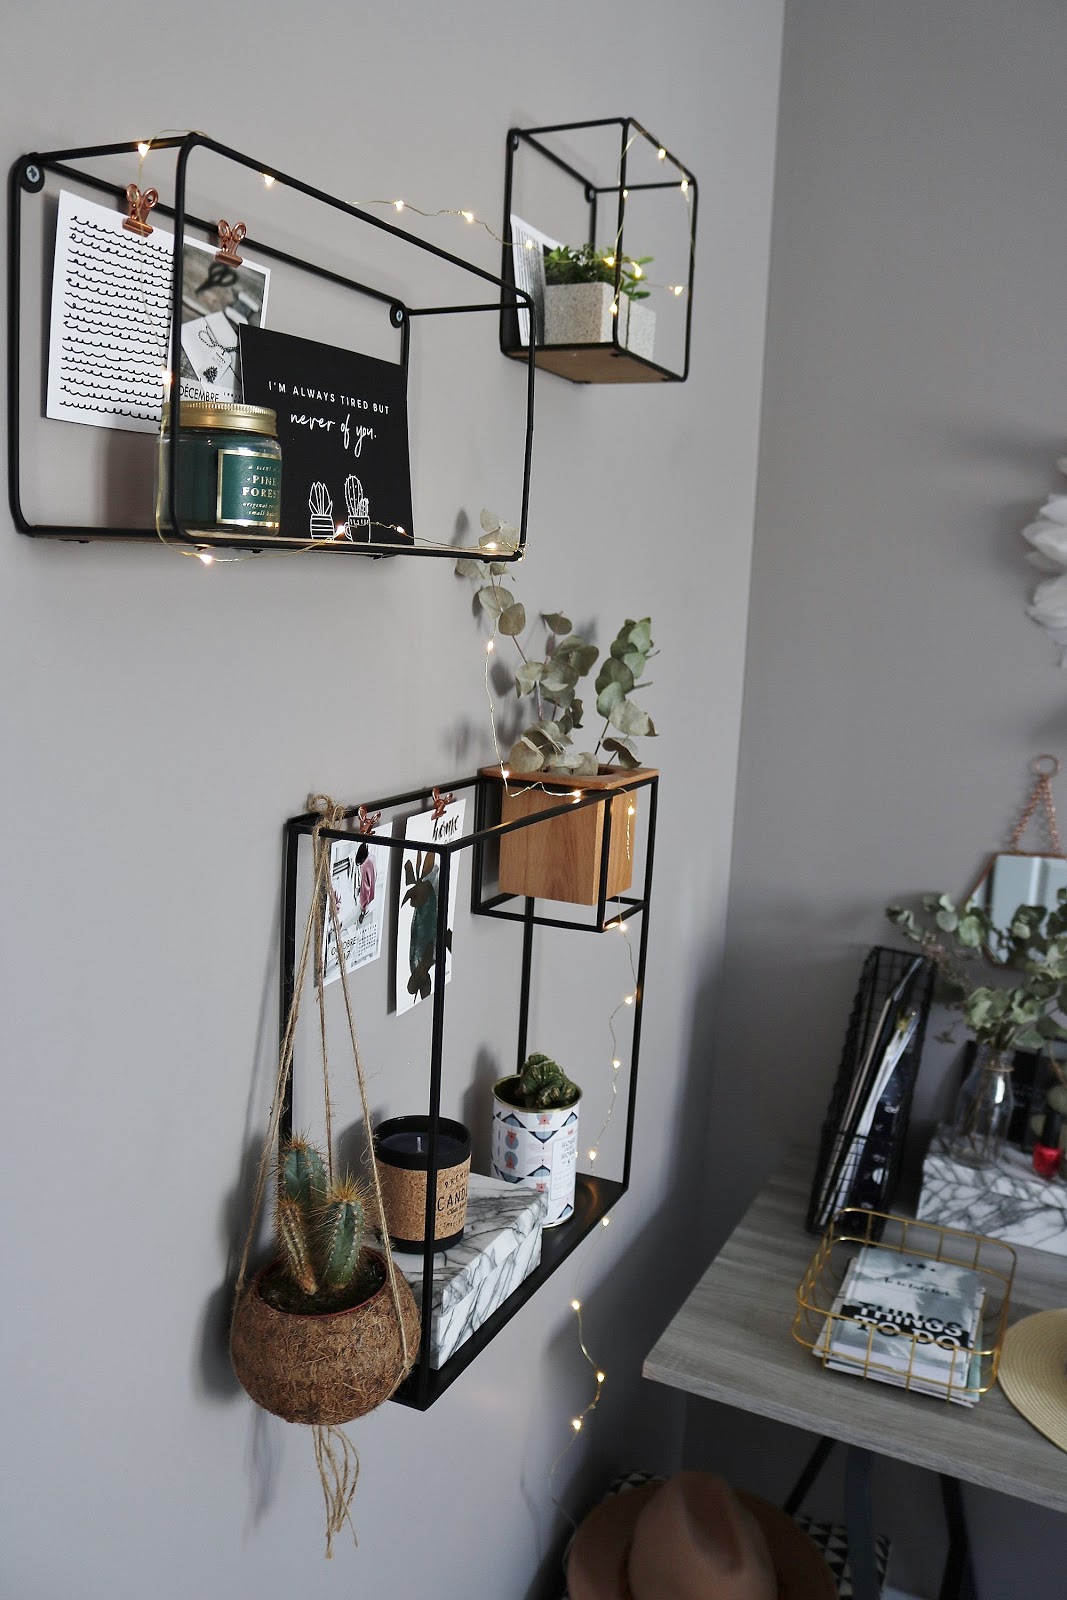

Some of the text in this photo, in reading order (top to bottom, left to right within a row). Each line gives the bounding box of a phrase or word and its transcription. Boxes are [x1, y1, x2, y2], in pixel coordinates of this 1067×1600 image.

[268, 380, 389, 415] I'M ALWAYS TIRED BUT
[290, 413, 377, 458] never of you.
[252, 474, 277, 487] PINE
[432, 814, 460, 842] home
[853, 1314, 961, 1351] TO DO
[858, 1301, 963, 1337] THINGS
